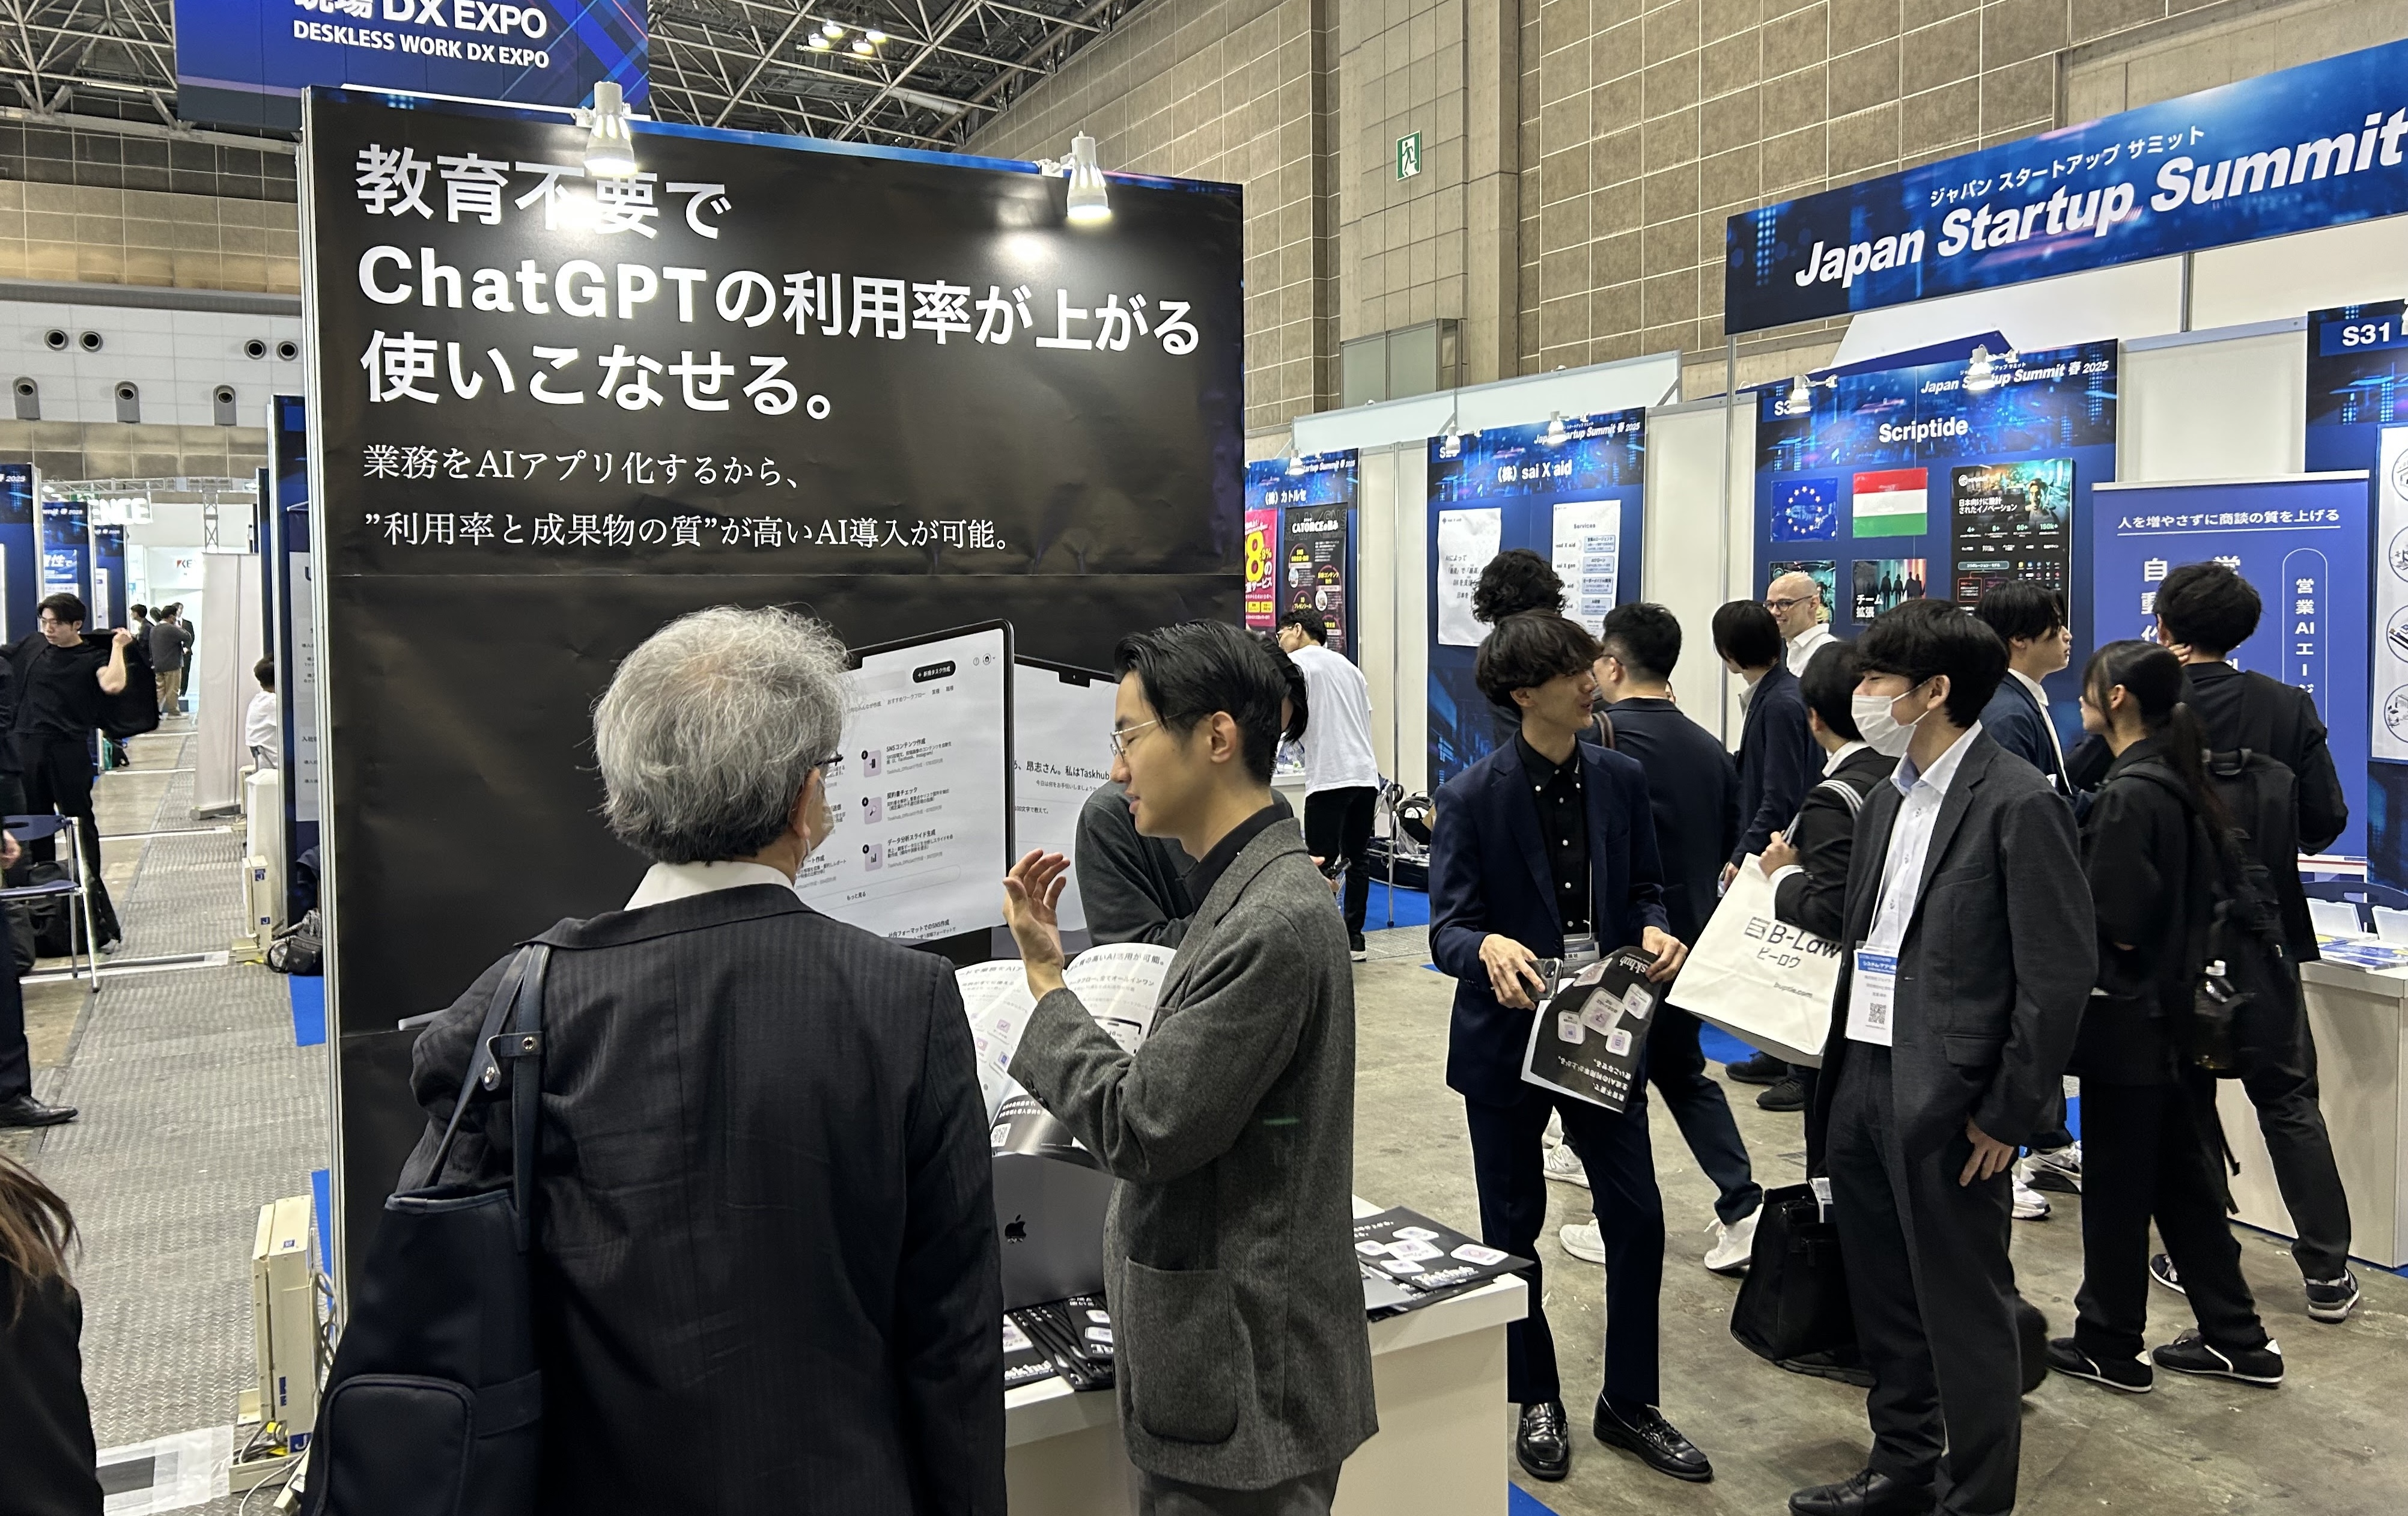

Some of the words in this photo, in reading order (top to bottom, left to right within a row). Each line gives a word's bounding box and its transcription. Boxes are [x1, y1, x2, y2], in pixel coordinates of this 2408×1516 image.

[383, 0, 448, 28] DX
[454, 2, 547, 39] EXPO
[293, 19, 395, 50] DESKLESS
[399, 34, 463, 59] WORK
[467, 41, 496, 63] DX
[498, 46, 549, 68] EXPO
[1930, 178, 1993, 207] ジャパン
[1998, 143, 2120, 192] スタートアップ
[2127, 125, 2204, 159] サミット
[356, 144, 732, 240] 教育不要で
[1795, 225, 1925, 289] Japan
[1936, 175, 2137, 259] Startup
[2151, 106, 2408, 213] Summit
[359, 245, 1200, 356] ChatGPTの利用率が上がる
[2343, 321, 2391, 347] S31
[361, 329, 831, 420] 使いこなせる。
[1921, 380, 1959, 395] Japan
[2013, 364, 2066, 383] Summit
[2068, 361, 2081, 376] 春
[2082, 361, 2109, 374] 2025
[1534, 434, 1548, 445] Jap
[1586, 424, 1616, 437] Summit
[1625, 422, 1641, 432] 2025
[1879, 416, 1969, 443] Scriptide
[363, 444, 798, 489] 業務をAIアプリ化するから、
[1521, 463, 1539, 480] sai
[1542, 461, 1551, 478] X
[1553, 459, 1572, 476] aid
[1959, 504, 2017, 515] されたイノベーション
[2117, 507, 2341, 530] 人を増やさずに商談の質を上げる
[1856, 594, 1884, 605] チーム
[1856, 606, 1875, 618] 拡張
[1767, 924, 1843, 958] B-Law
